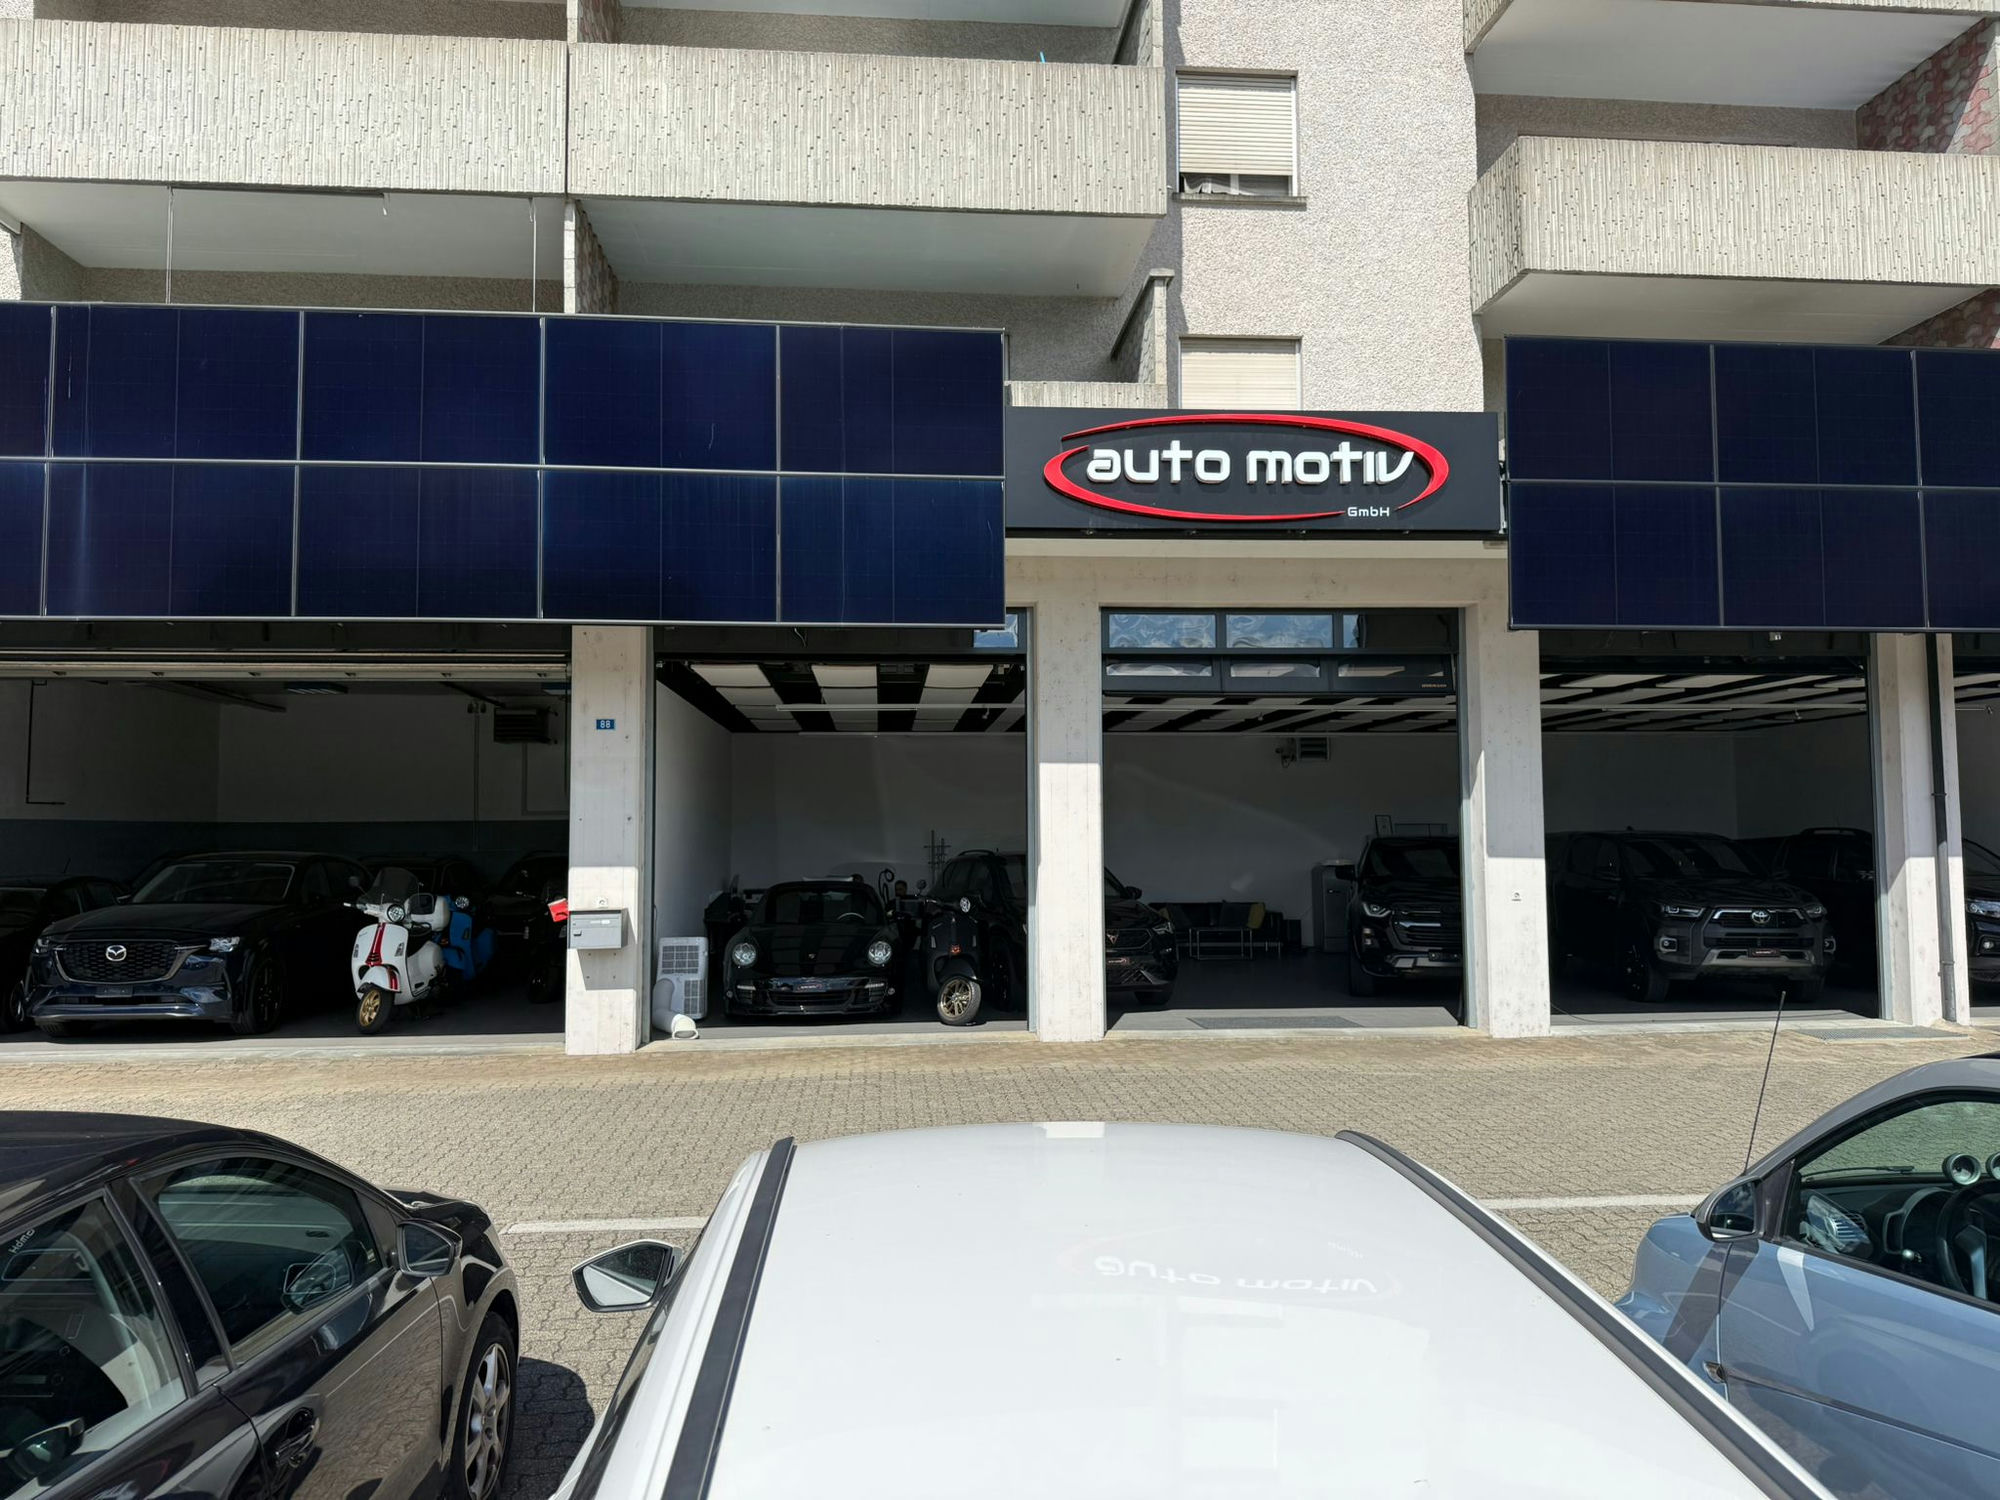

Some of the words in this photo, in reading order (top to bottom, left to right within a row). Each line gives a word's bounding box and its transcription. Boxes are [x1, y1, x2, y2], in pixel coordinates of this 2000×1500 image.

[1087, 440, 1231, 484] auto
[1246, 441, 1415, 485] motiv
[1347, 506, 1390, 518] GmbH
[600, 720, 611, 729] 88
